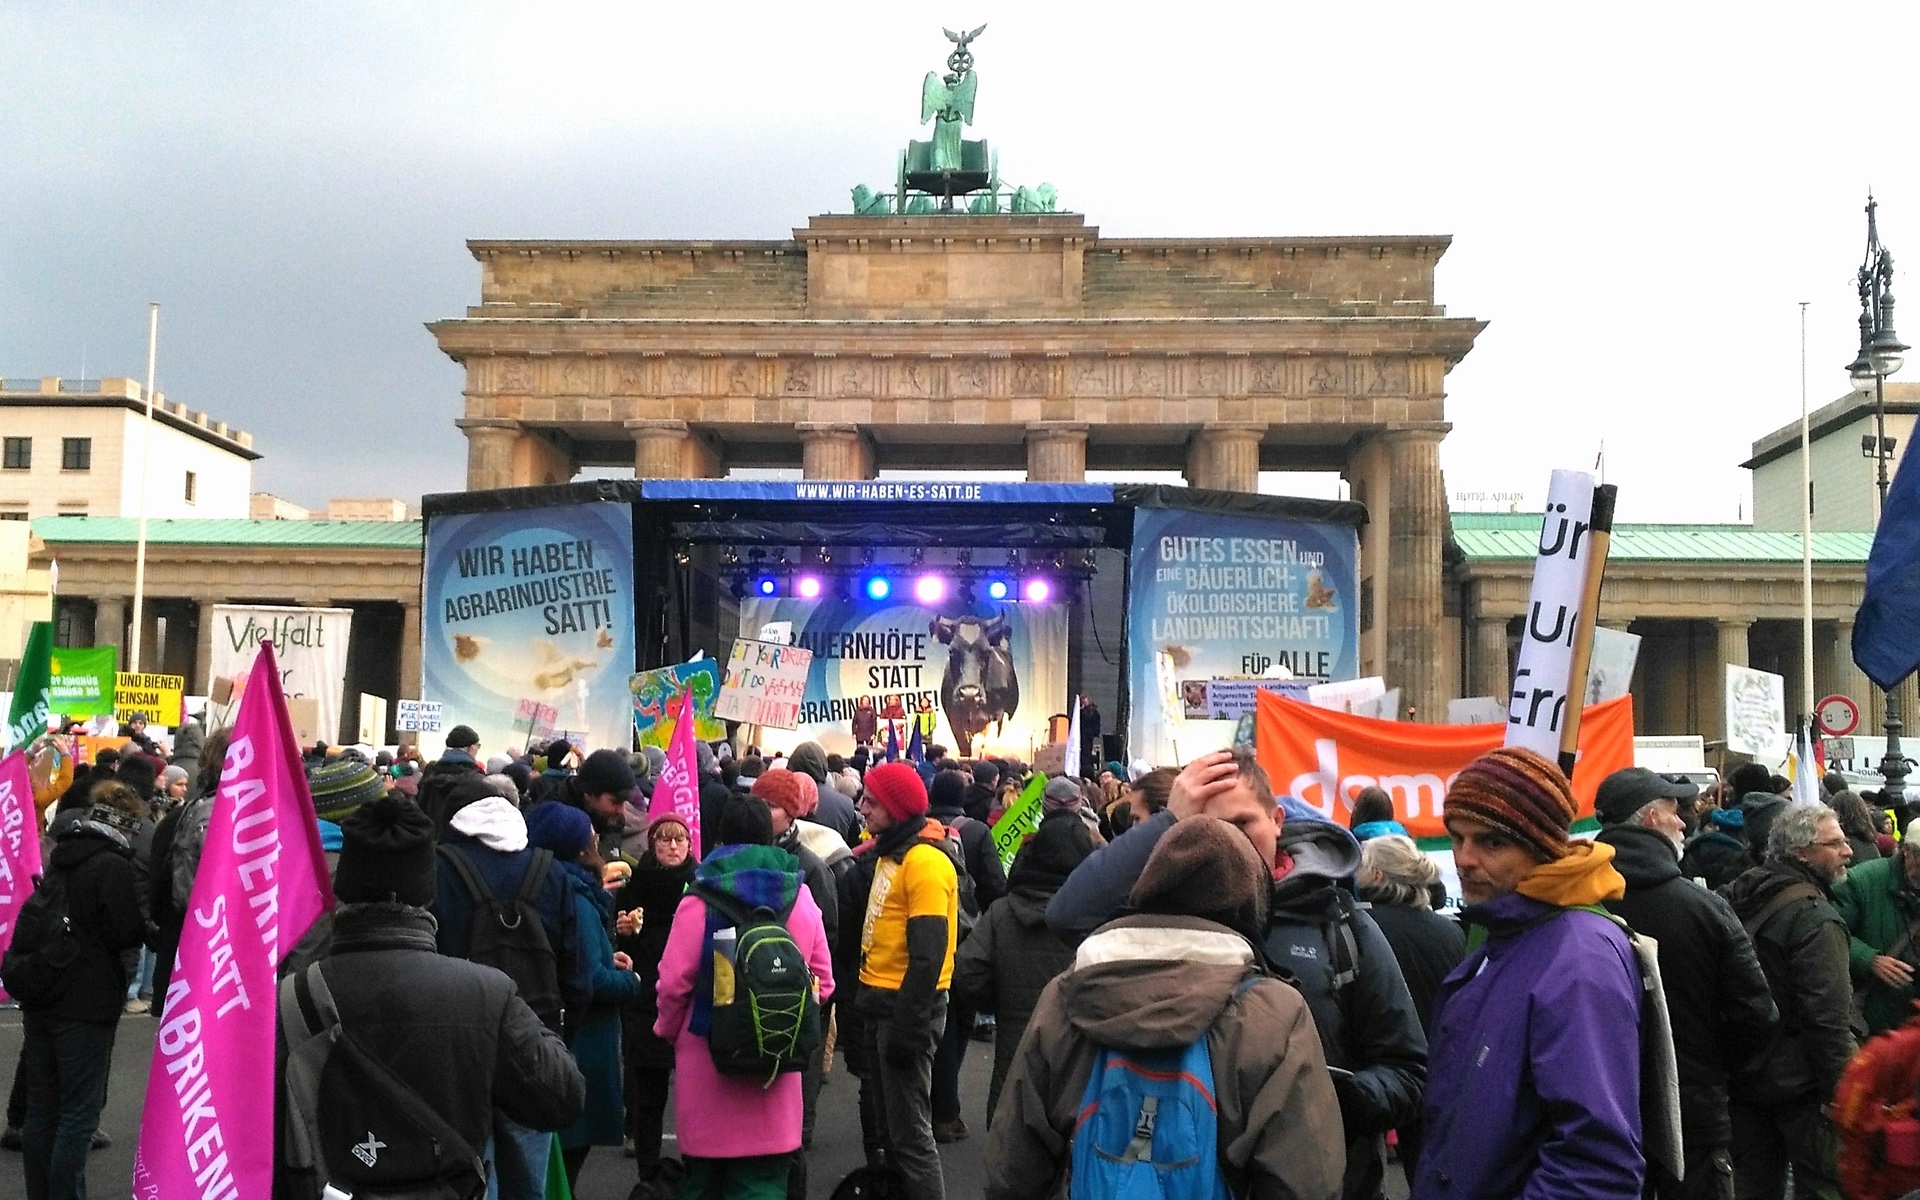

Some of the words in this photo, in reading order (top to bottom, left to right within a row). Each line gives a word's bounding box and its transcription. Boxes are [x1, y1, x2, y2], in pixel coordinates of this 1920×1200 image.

[796, 484, 981, 499] WWW.WIR-HABEN-ES-SATT.DE
[1456, 492, 1487, 501] HOTEL
[1491, 492, 1524, 501] ADLON
[457, 545, 505, 578] WIR
[512, 540, 594, 577] HABEN
[1160, 536, 1224, 562] GUTES
[1231, 538, 1297, 564] ESSEN
[1300, 551, 1324, 566] UND
[1156, 568, 1181, 581] EINE
[1185, 564, 1297, 590] BÄUERLICH-
[445, 569, 617, 623] AGRARINDUSTRIE
[1167, 592, 1299, 614] ÖKOLOGISCHERE
[543, 599, 613, 635] SATT!
[1152, 616, 1330, 640] LANDWIRTSCHAFT!
[225, 615, 325, 658] Vielfalt
[120, 674, 141, 687] UND
[144, 675, 181, 690] BIENEN
[868, 665, 923, 688] STATT
[115, 708, 162, 723] VIEALT
[194, 894, 251, 1019] STATT
